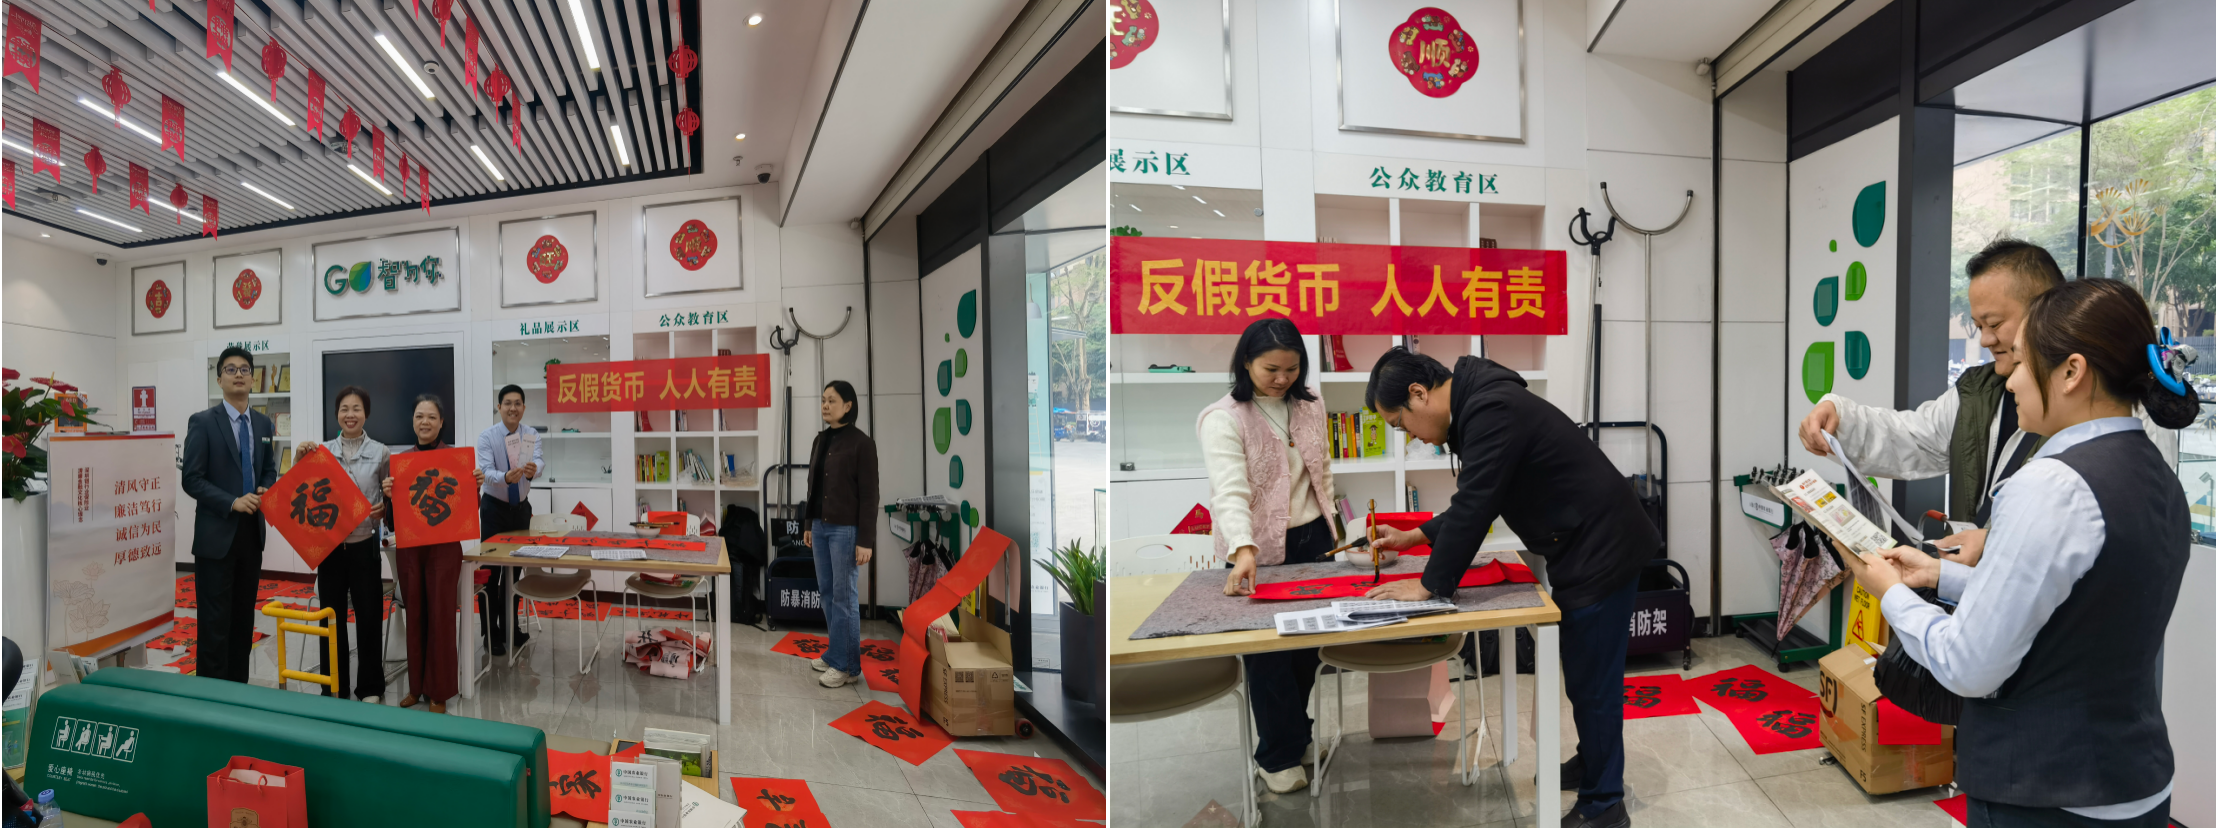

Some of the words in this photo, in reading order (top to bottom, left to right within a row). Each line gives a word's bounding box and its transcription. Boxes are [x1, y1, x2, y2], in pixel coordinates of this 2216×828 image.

[1419, 38, 1451, 68] 顺
[1110, 149, 1190, 176] 展示区
[1369, 166, 1499, 194] 公众教育区
[1137, 258, 1340, 317] 反假货币
[1370, 263, 1546, 319] 人人有责
[520, 319, 580, 336] 礼品展示区
[659, 310, 729, 327] 公众教育区
[557, 371, 645, 403] 反假货币
[659, 365, 758, 400] 人人有责
[114, 476, 161, 495] 清风守正
[409, 468, 459, 527] 福
[114, 498, 162, 519] 廉洁笃行
[289, 477, 339, 530] 福
[116, 520, 162, 542] 诚信为民
[786, 520, 799, 535] 防
[114, 542, 162, 566] 厚德致远
[1711, 677, 1768, 702] 福
[1860, 702, 1867, 716] SF
[865, 714, 924, 741] 福
[1757, 710, 1817, 738] 福
[48, 764, 73, 776] 爱心座椅
